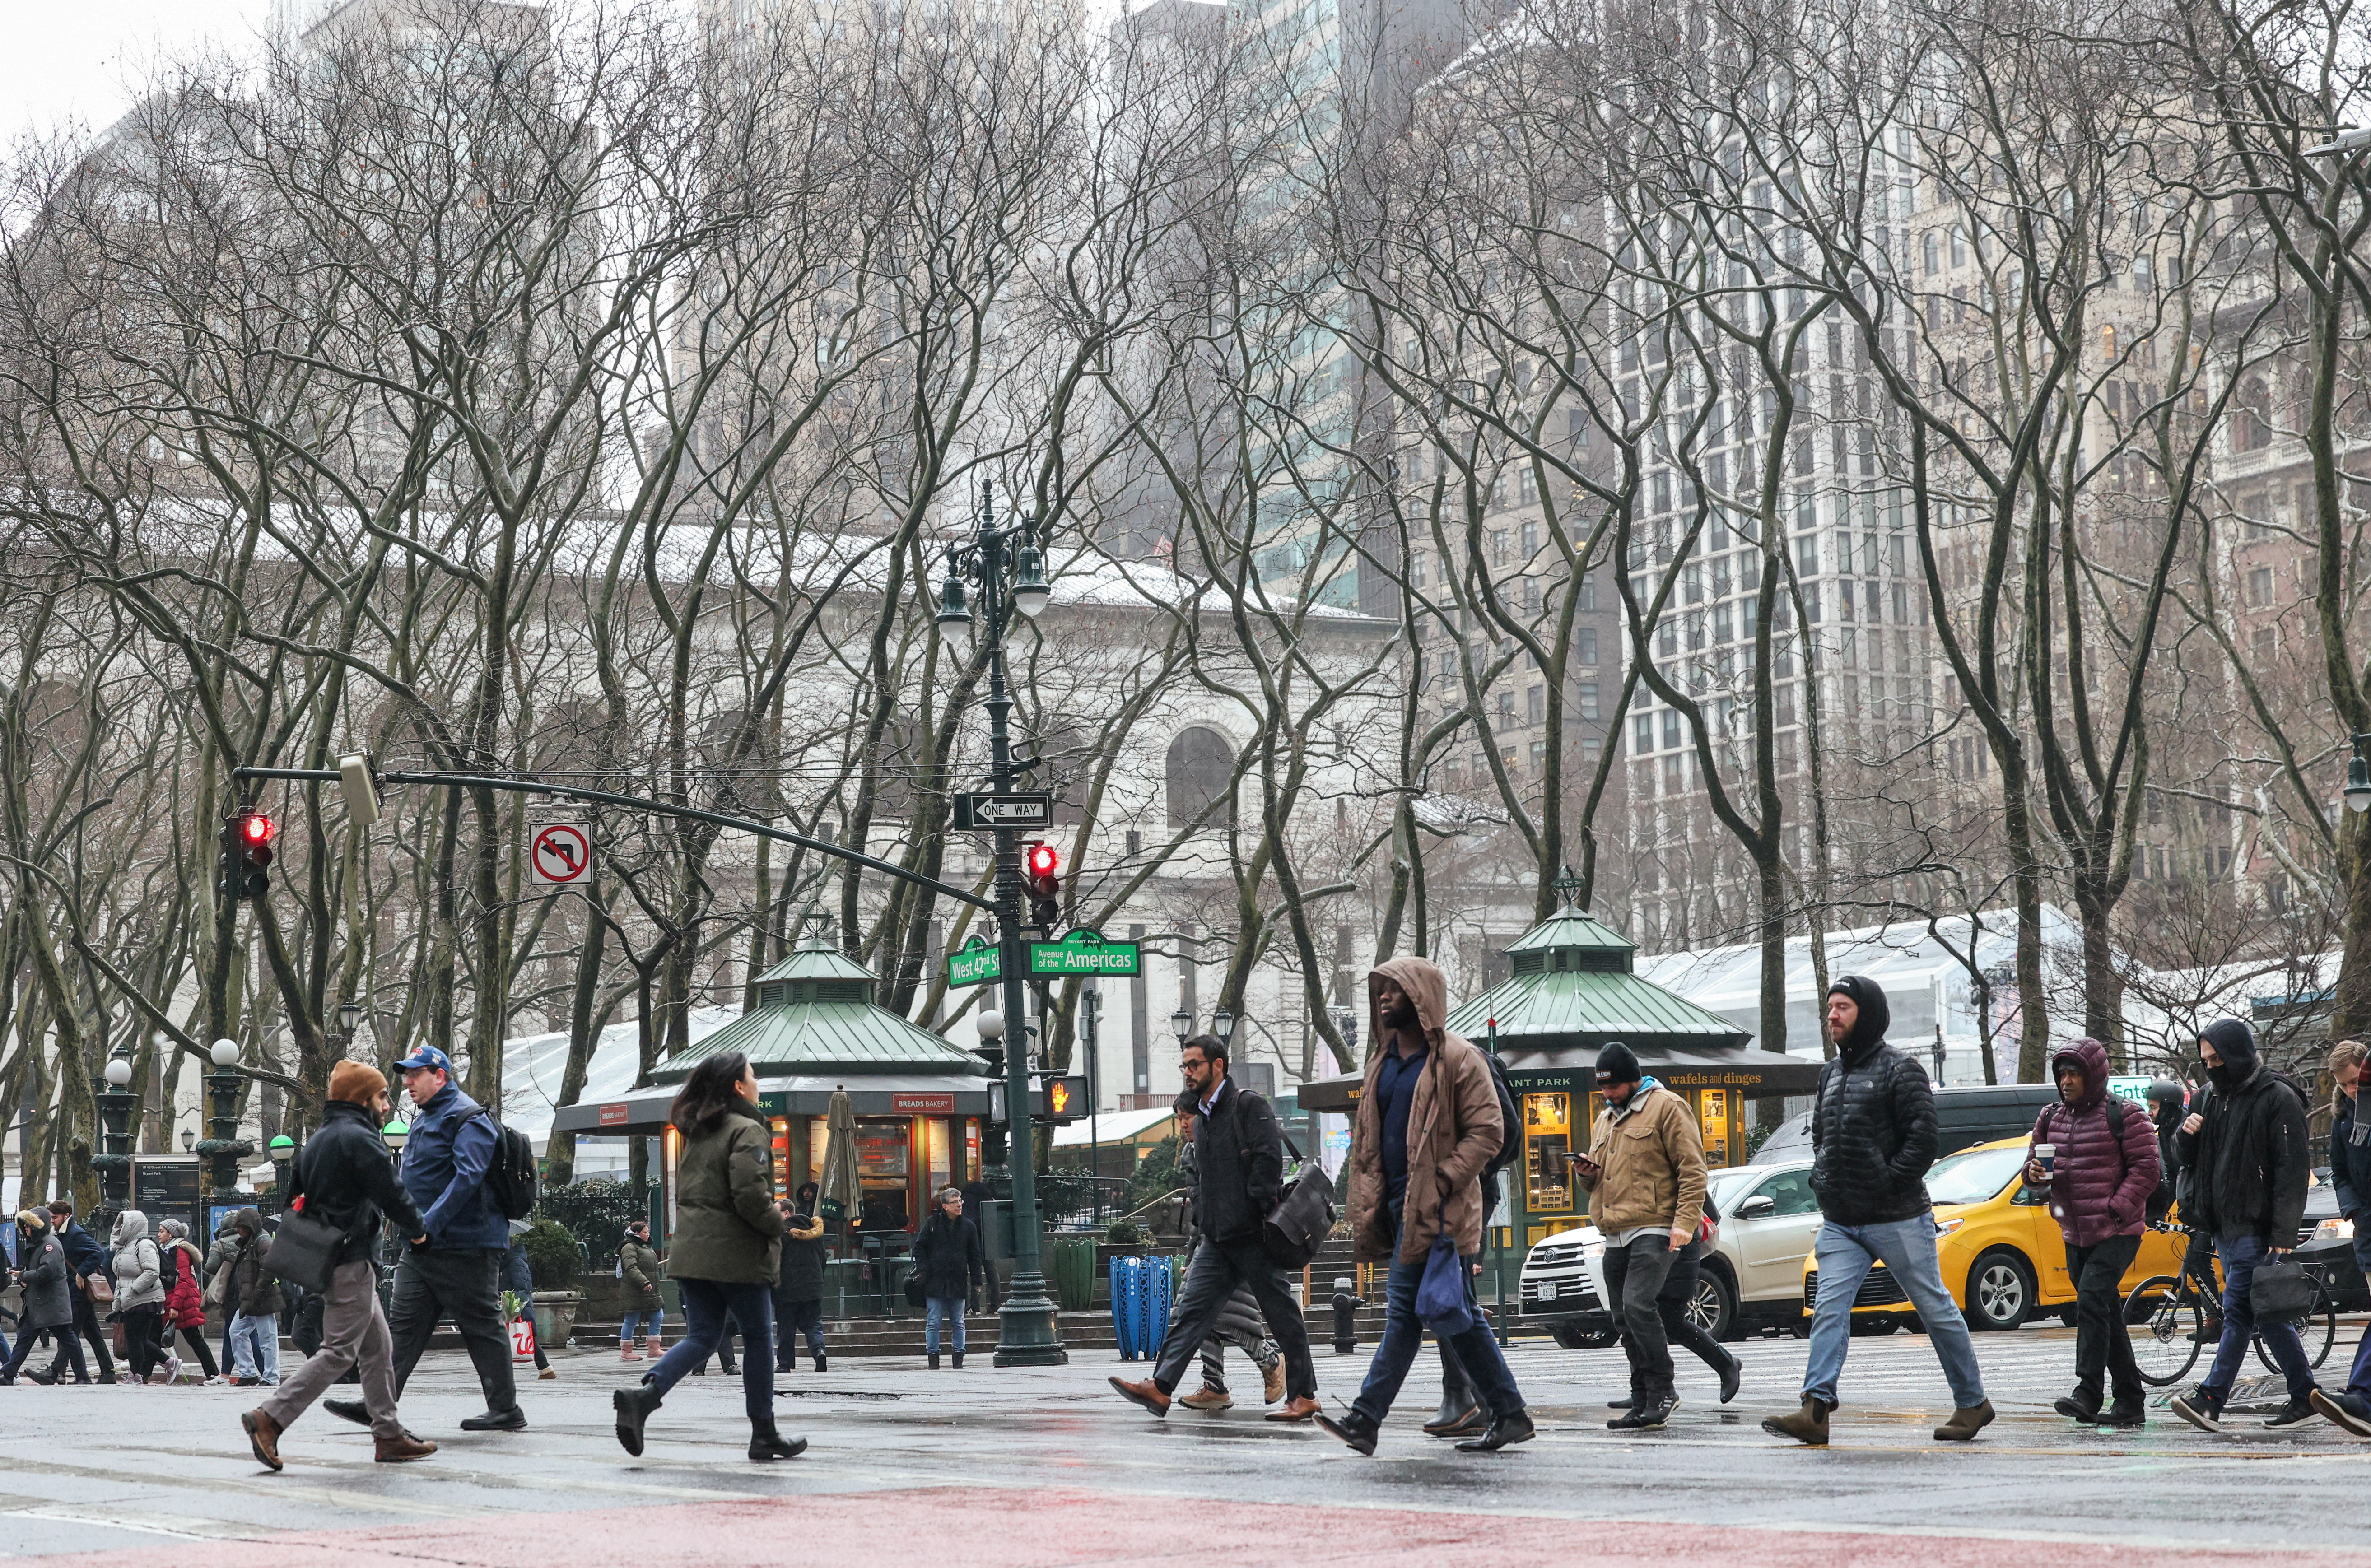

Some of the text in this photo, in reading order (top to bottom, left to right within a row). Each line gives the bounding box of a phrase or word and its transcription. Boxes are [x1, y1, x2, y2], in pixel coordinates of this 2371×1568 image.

[984, 805, 1037, 816] ONE WAY
[1038, 949, 1131, 968] Avenue Americas
[1039, 958, 1059, 968] of the
[952, 953, 1000, 979] West 42nd St
[1537, 1077, 1571, 1086] PARK
[1669, 1072, 1761, 1086] wafels and dinges
[1348, 1086, 1363, 1098] waf
[757, 1100, 772, 1108] RK
[1539, 1287, 1556, 1297] T103722C
[2195, 1273, 2224, 1313] TREK
